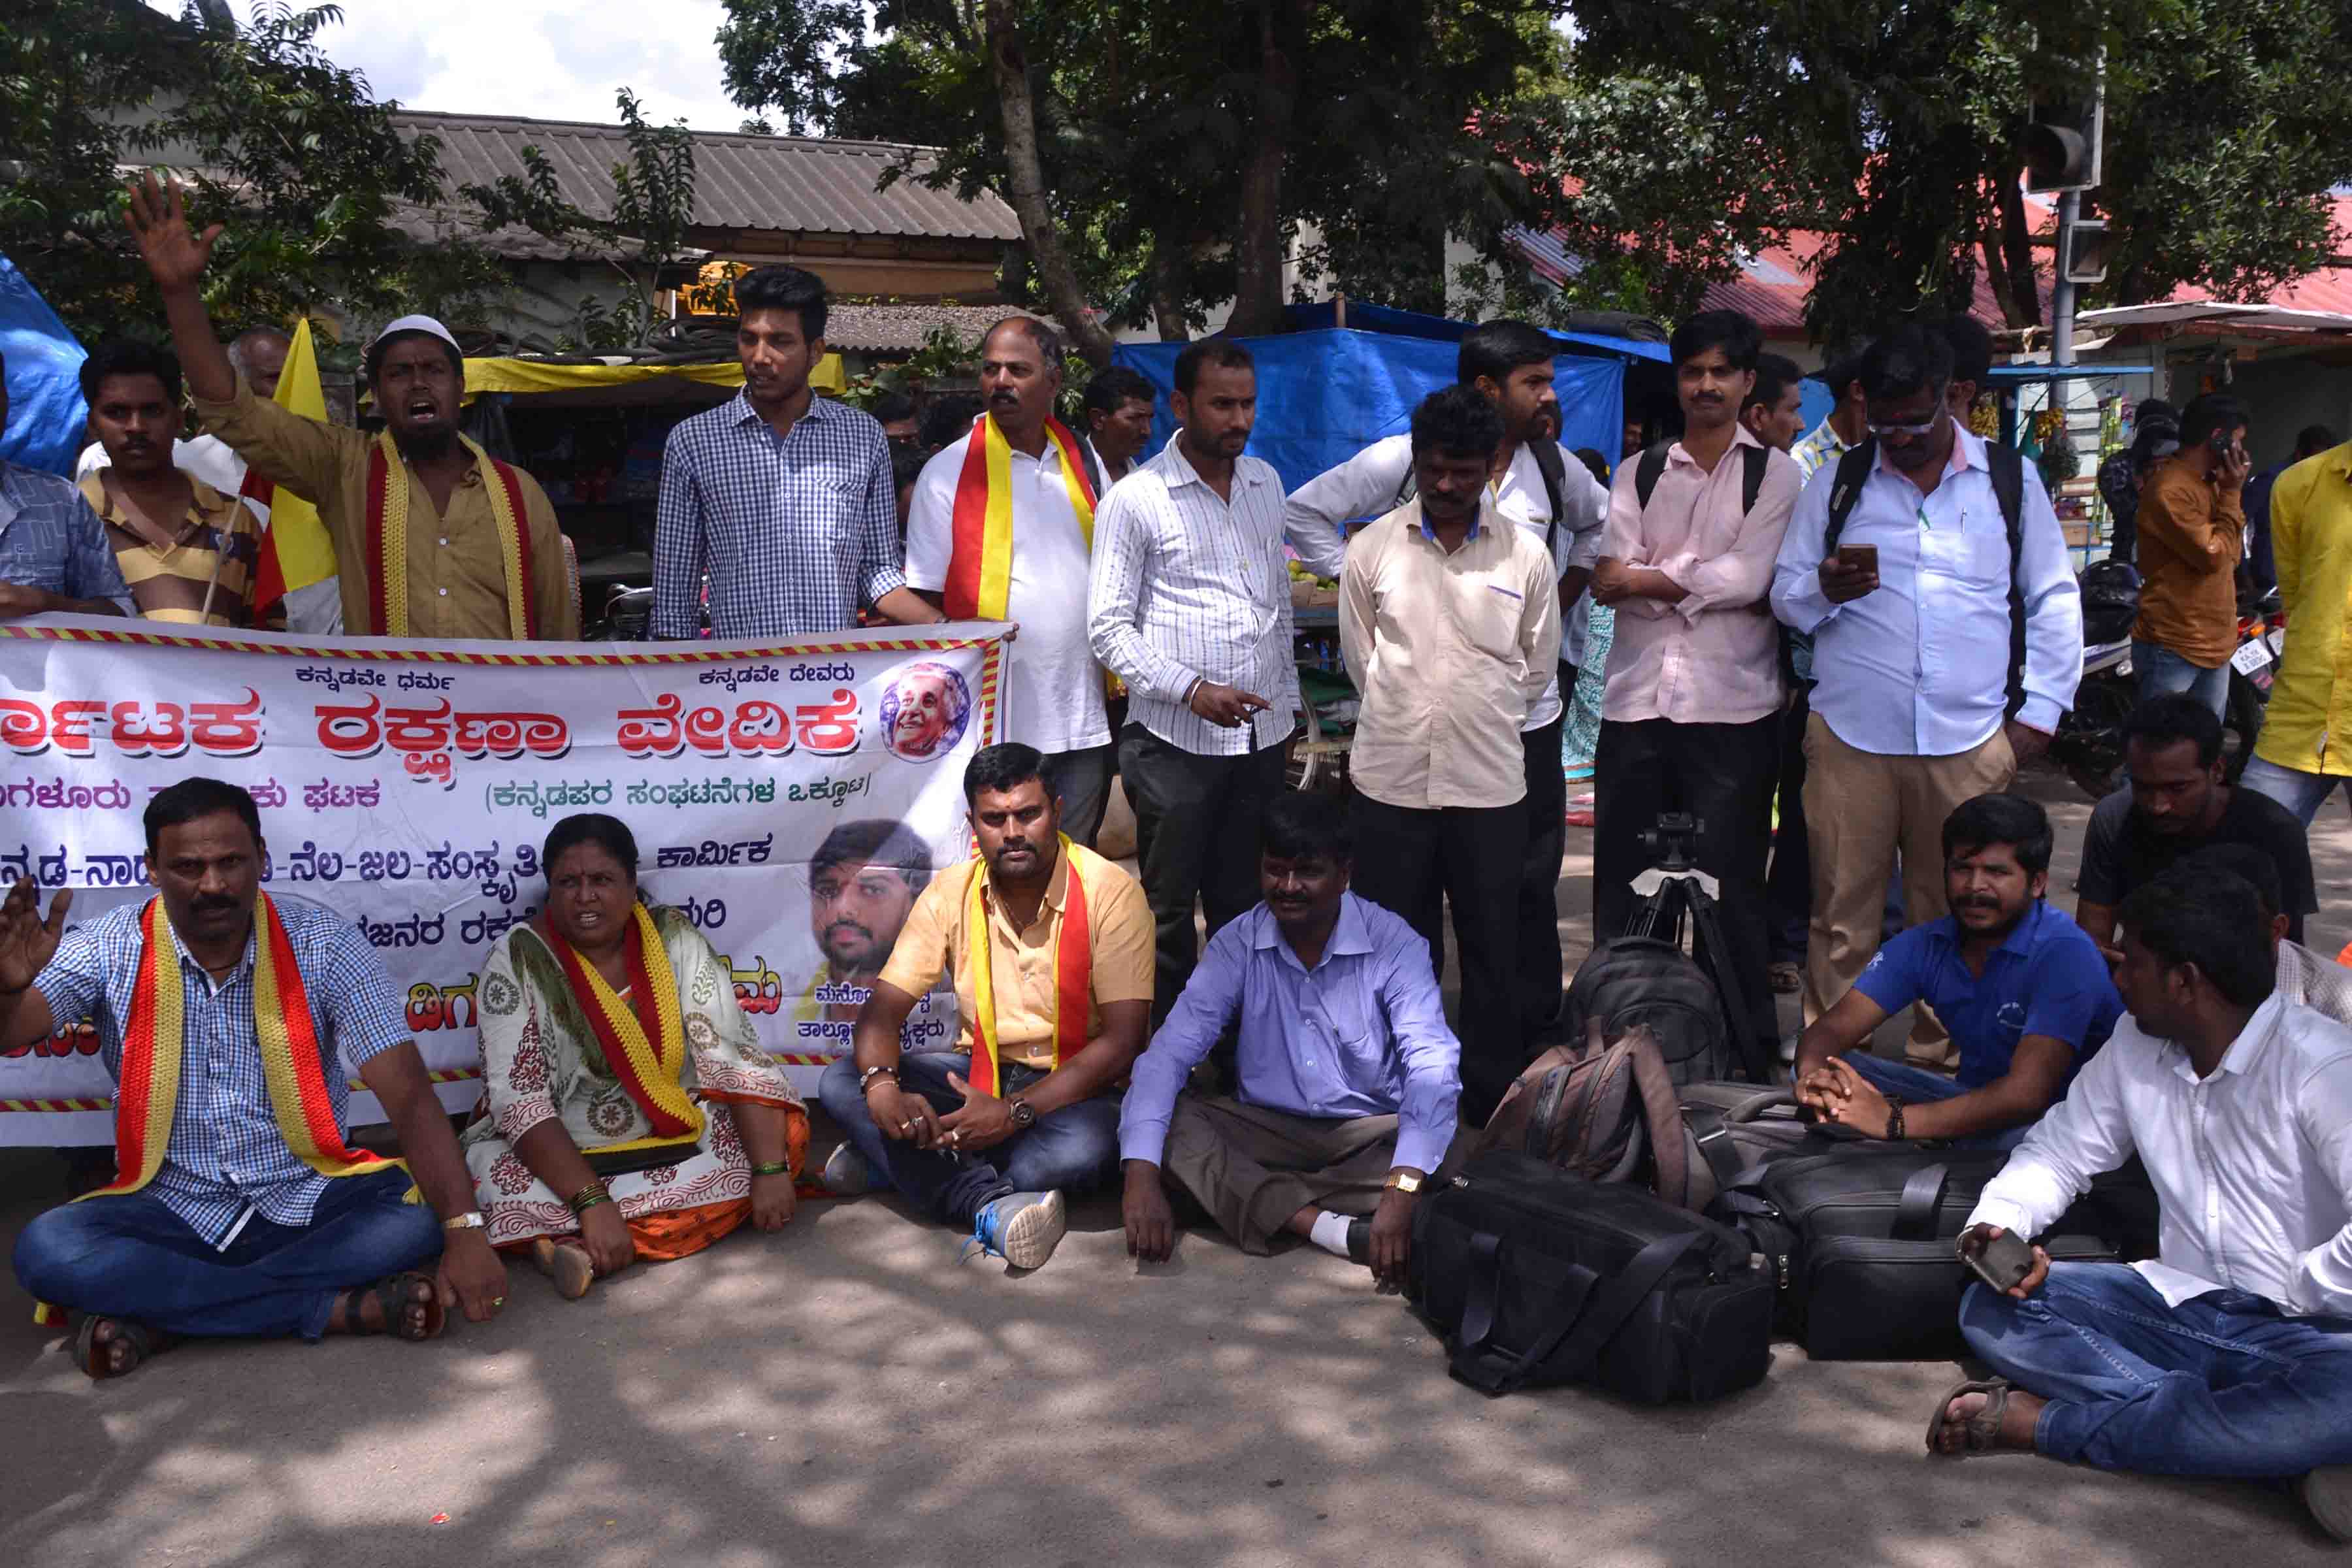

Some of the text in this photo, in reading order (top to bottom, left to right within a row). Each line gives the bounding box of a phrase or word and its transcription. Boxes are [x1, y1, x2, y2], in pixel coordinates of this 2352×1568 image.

[295, 666, 455, 693] ಕನ್ನಡವೇ ಧರ್ಮ
[698, 662, 855, 693] ಕನ್ನಡವೇ ದೇವರು
[315, 691, 570, 788] ರಕ್ಷಣಾ
[617, 689, 860, 758] ವೇದಿಕೆ
[0, 776, 131, 809] ಗಳೂರು
[303, 777, 380, 813] ಘಟಕ
[627, 776, 776, 809] ಸಂಘಟನೆಗಳ
[657, 832, 773, 868] ಕಾರ್ಮಿಕ
